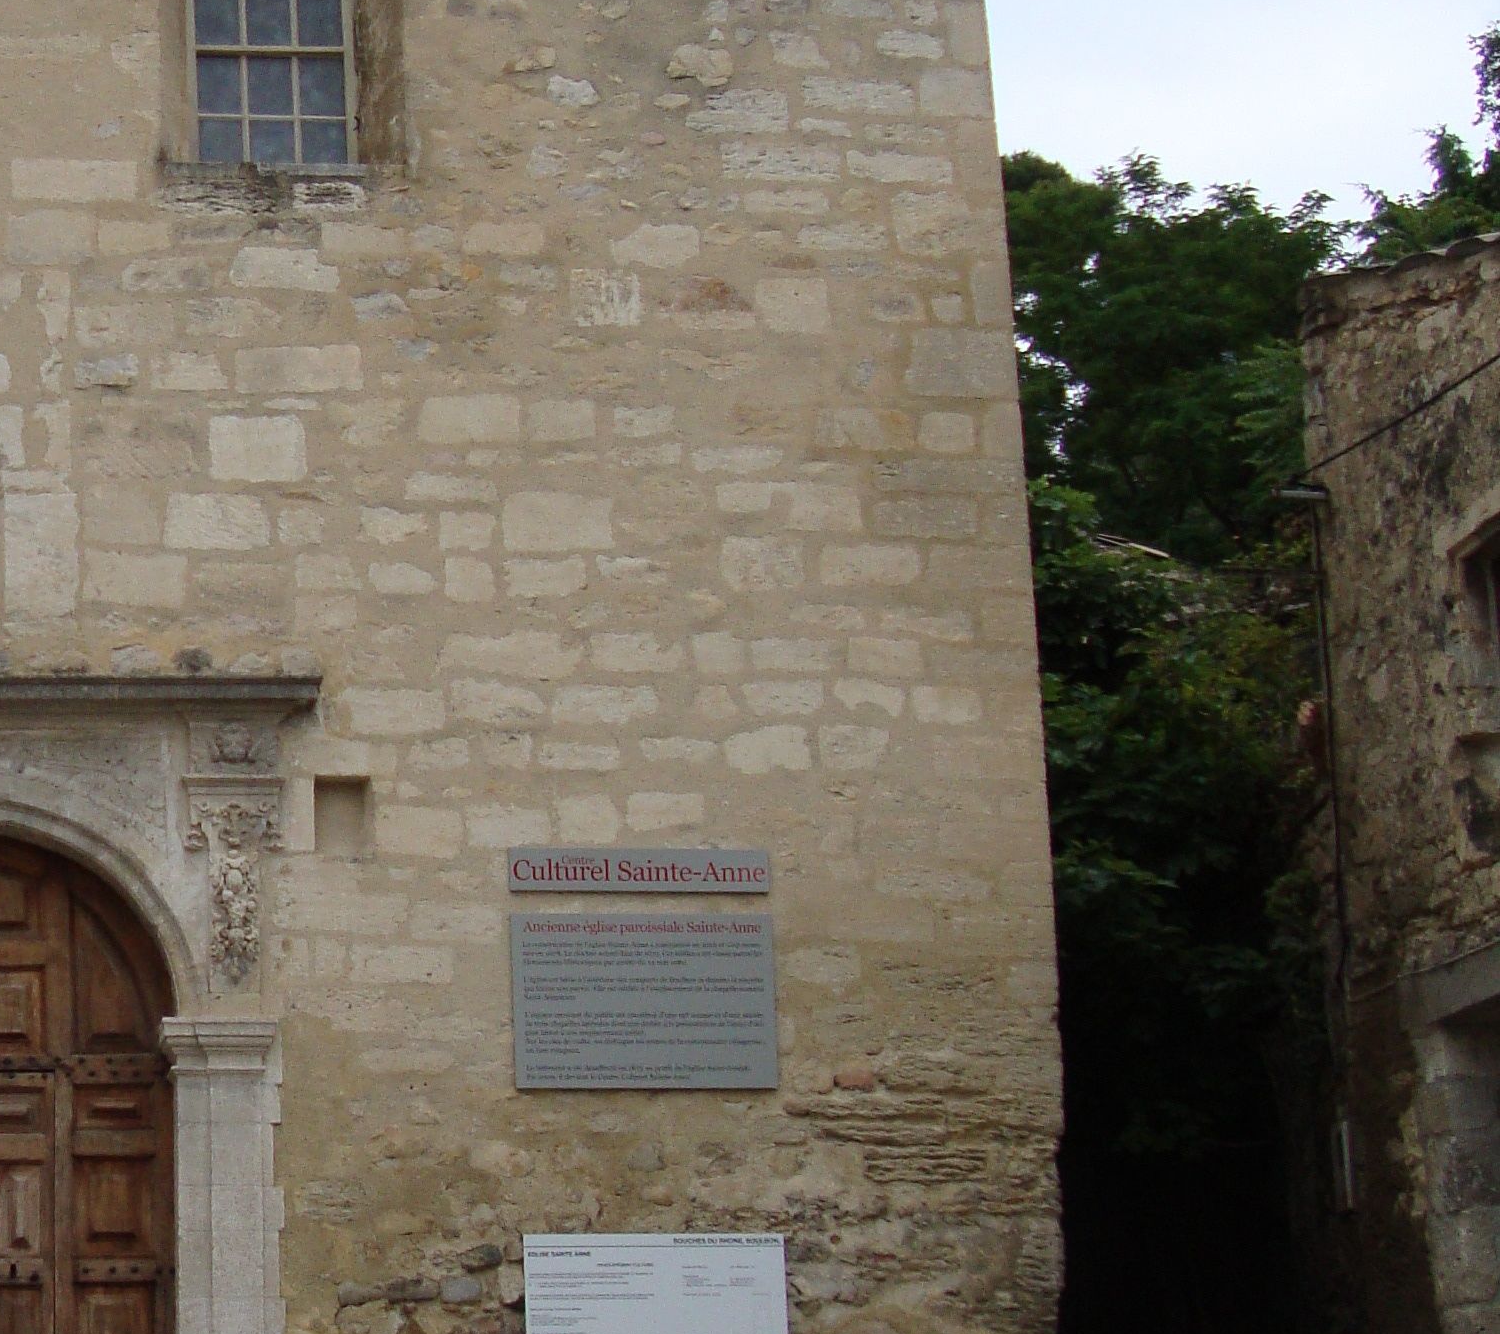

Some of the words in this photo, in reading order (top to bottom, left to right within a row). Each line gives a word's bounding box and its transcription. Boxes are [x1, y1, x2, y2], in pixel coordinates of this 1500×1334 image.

[561, 855, 596, 866] Centre
[513, 859, 610, 882] Culturel
[618, 860, 766, 884] Sainte-Anne
[523, 921, 580, 933] Ancienne
[583, 920, 617, 935] église
[620, 921, 684, 936] paroissiale
[687, 921, 761, 934] Sainte-Anne
